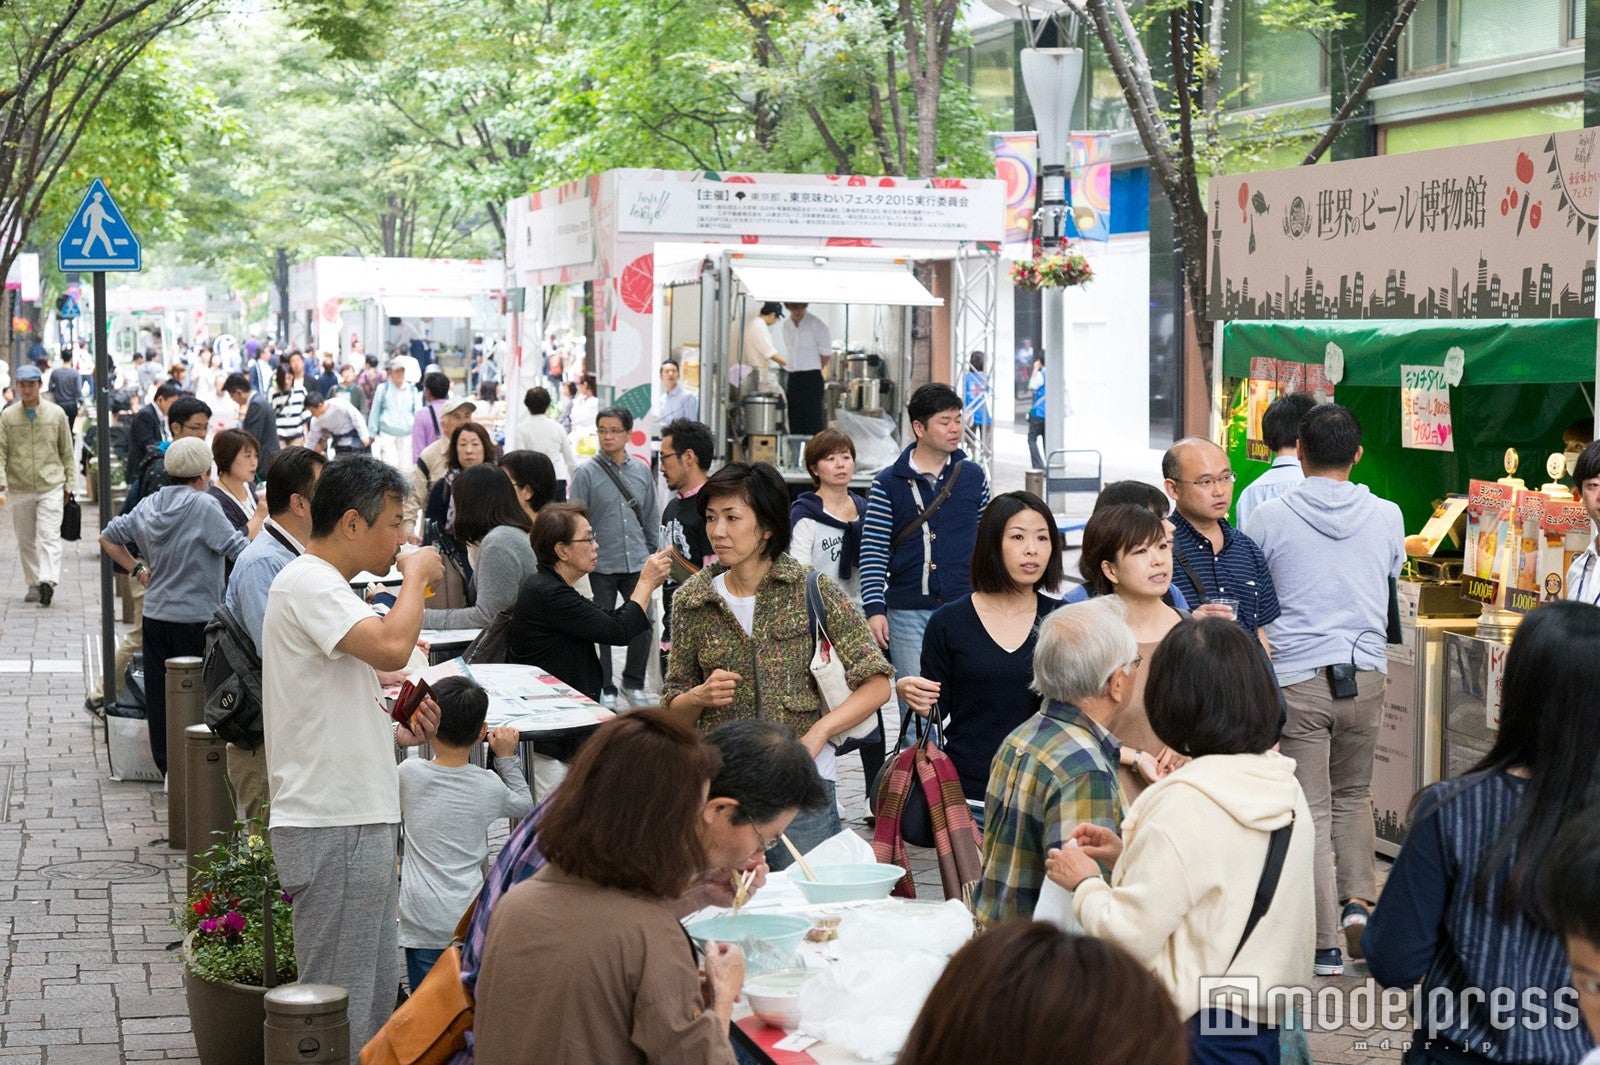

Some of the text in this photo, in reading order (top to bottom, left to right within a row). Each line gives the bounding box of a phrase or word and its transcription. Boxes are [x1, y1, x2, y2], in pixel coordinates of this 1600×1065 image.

[1316, 175, 1488, 241] 世界のビール博物館
